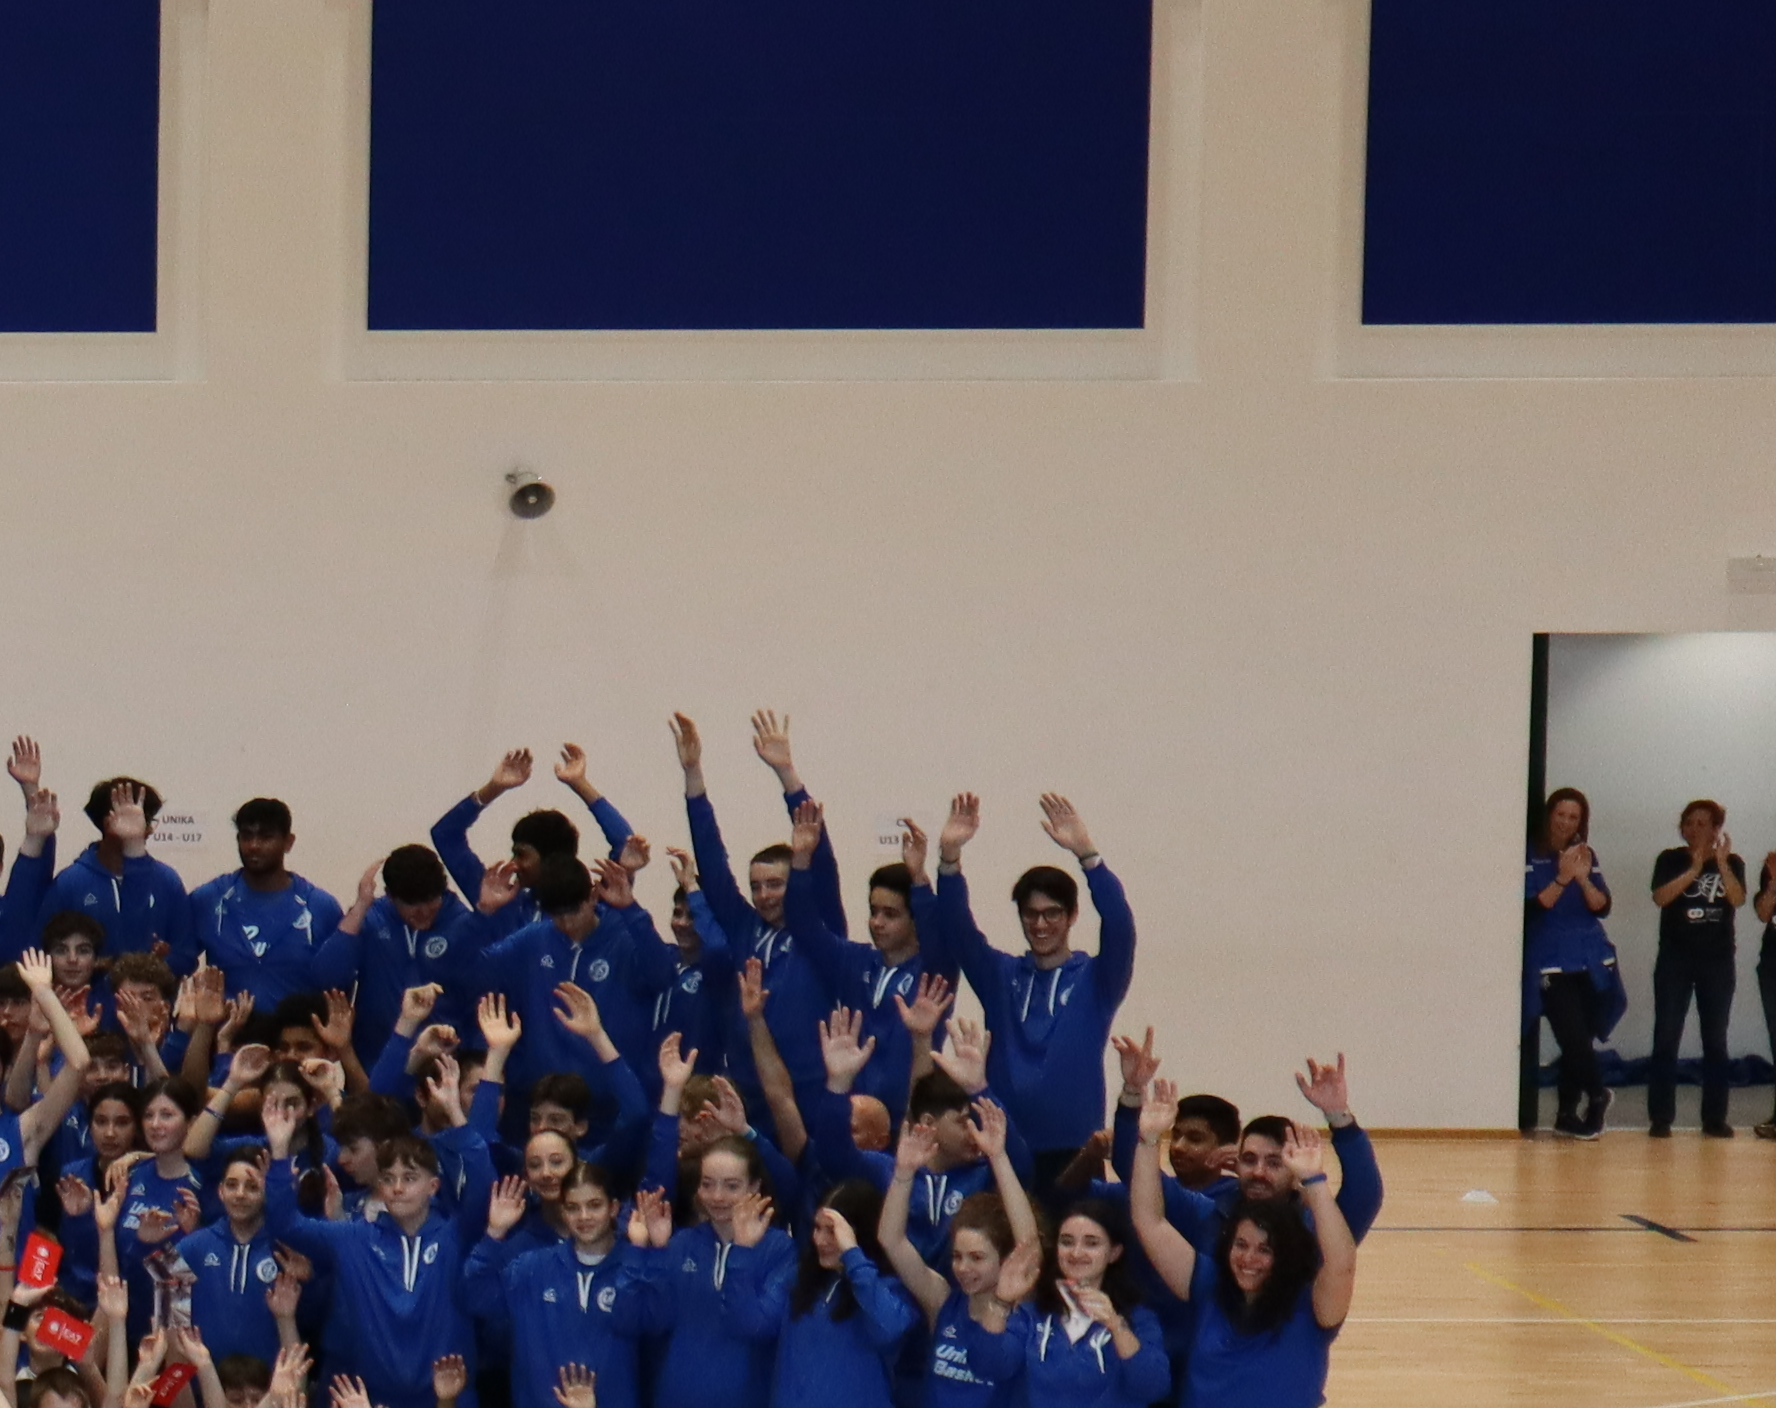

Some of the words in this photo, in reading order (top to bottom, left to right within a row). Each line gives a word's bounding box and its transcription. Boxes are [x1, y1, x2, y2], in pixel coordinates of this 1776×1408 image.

[162, 815, 195, 825] UNIKA
[153, 832, 176, 843] U14
[183, 832, 203, 843] U17
